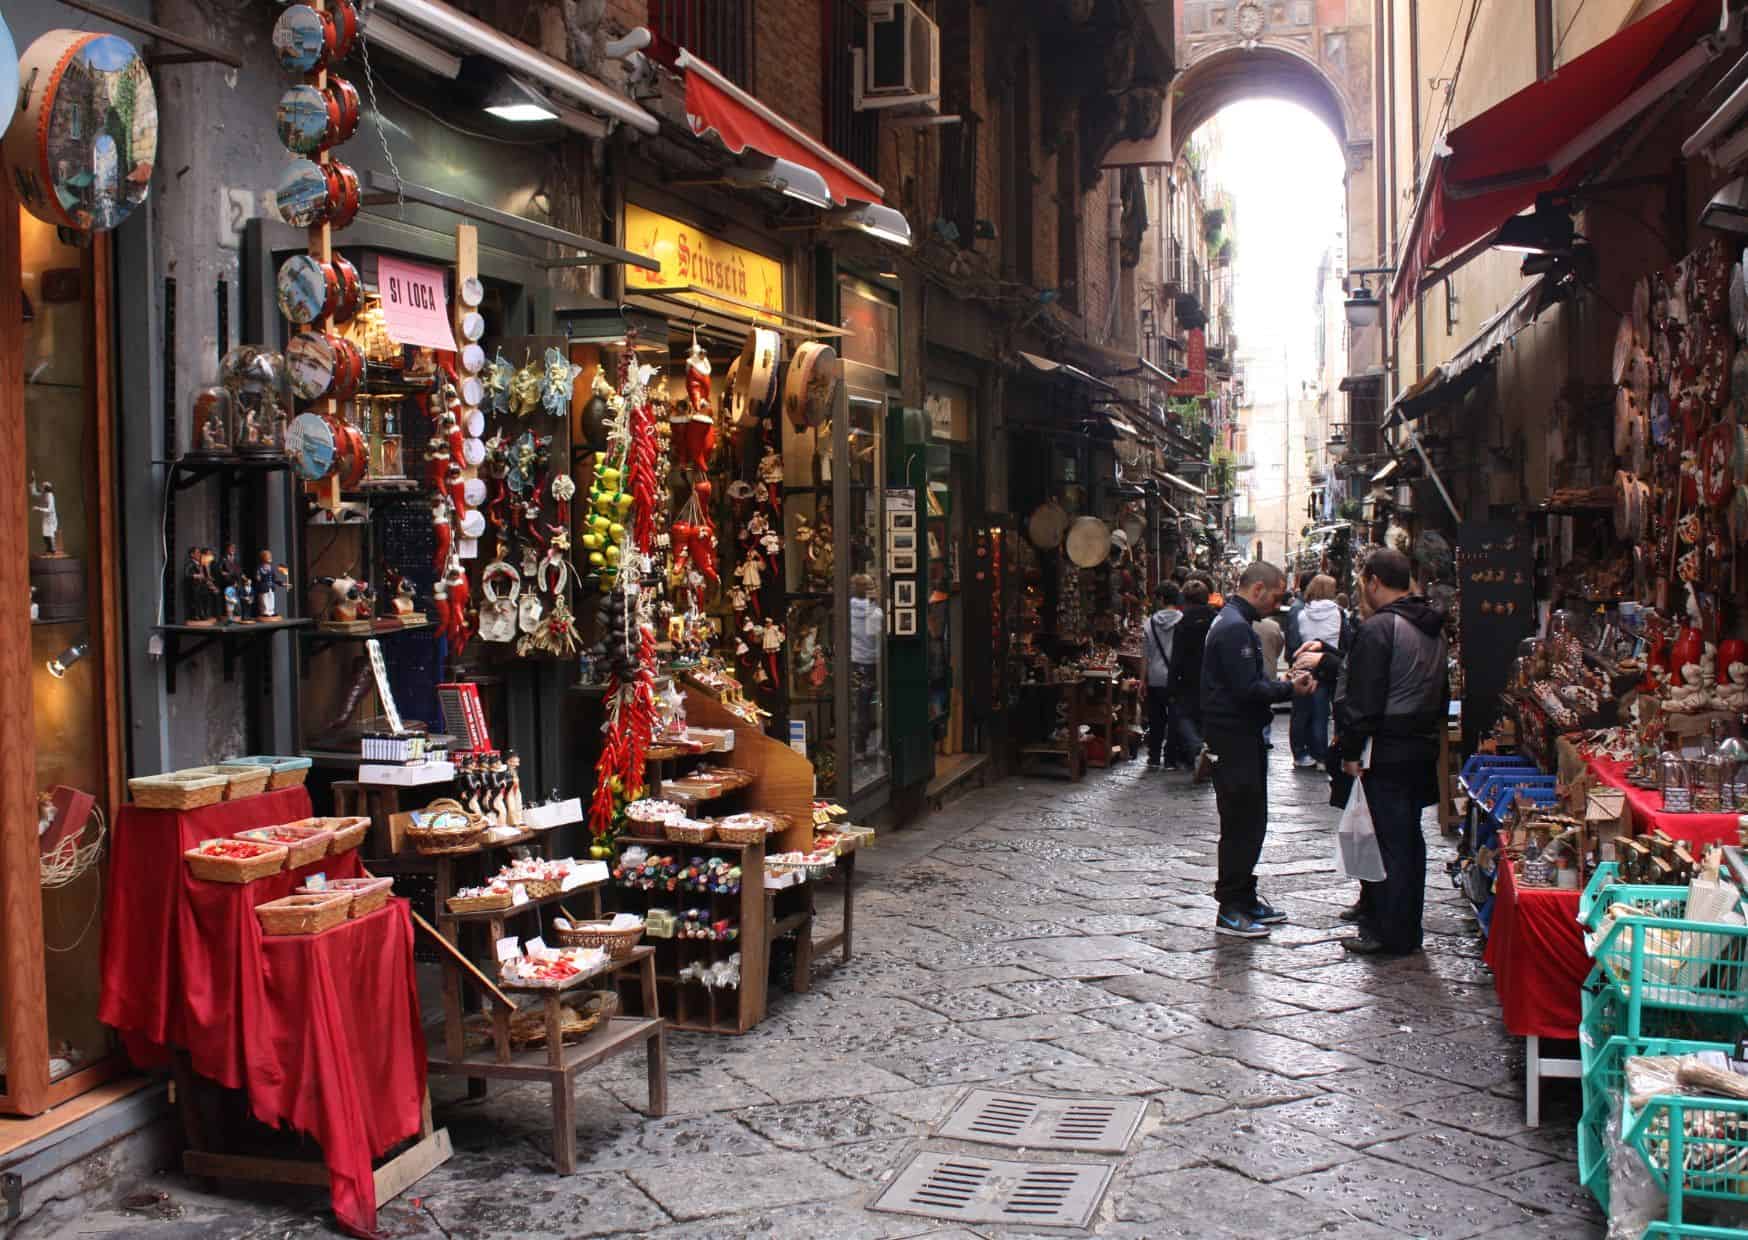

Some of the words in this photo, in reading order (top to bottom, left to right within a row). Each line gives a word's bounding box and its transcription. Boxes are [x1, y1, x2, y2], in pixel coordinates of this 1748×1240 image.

[678, 232, 747, 297] Sciuscià
[389, 276, 402, 304] SI
[407, 280, 437, 312] LOCA
